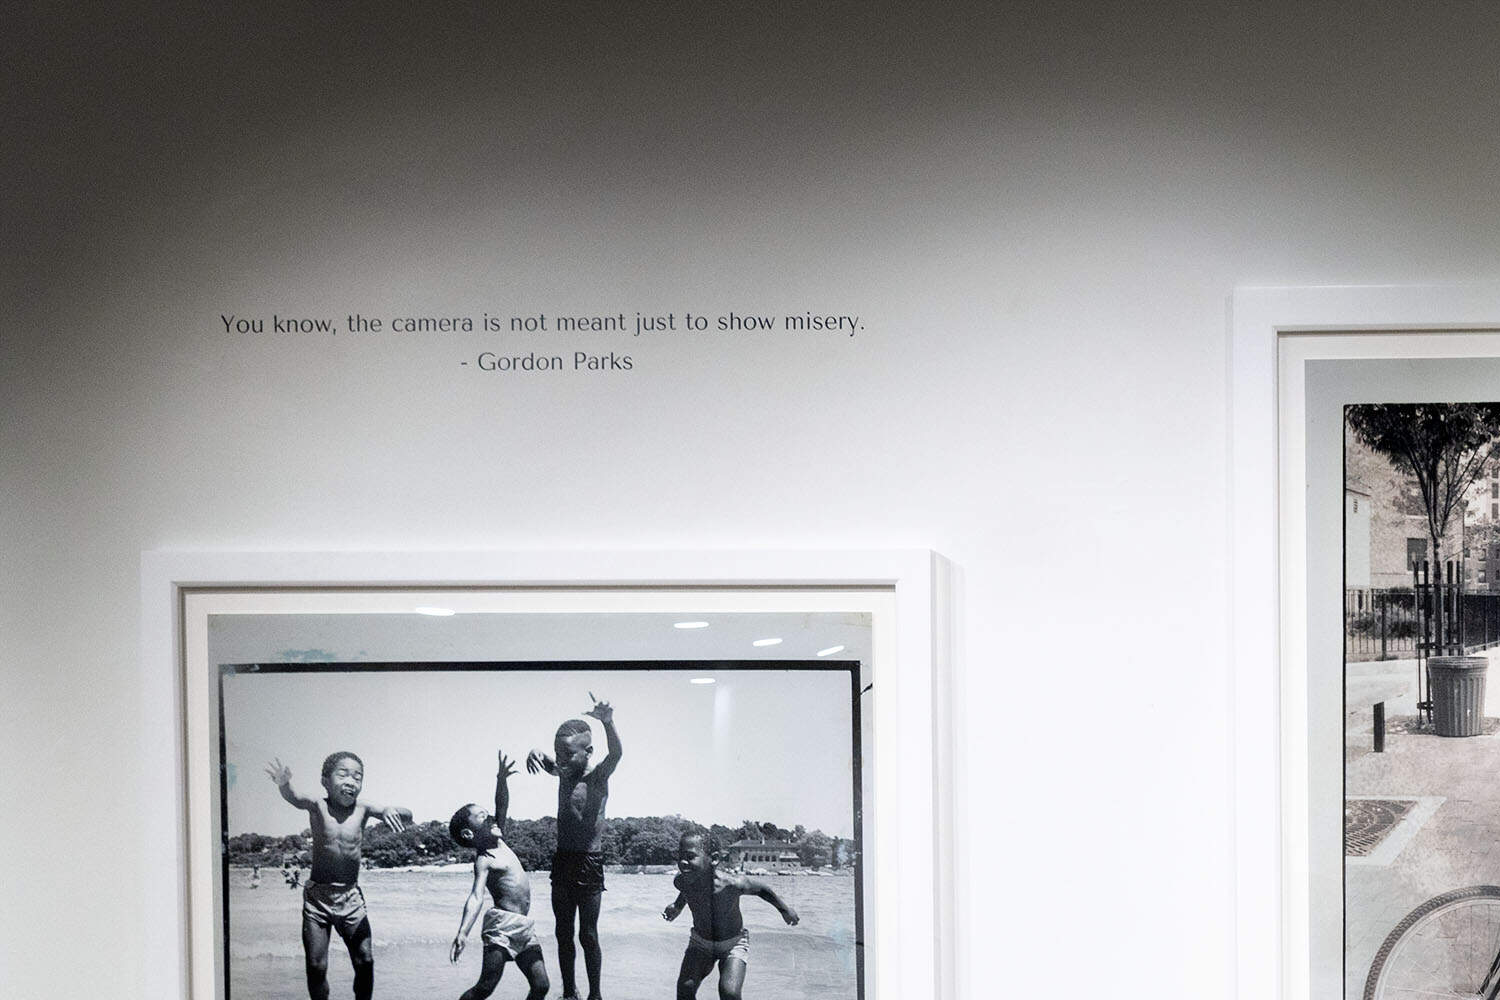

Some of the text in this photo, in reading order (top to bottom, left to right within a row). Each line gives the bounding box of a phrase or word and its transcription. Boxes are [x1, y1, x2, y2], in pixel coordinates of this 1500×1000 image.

[220, 311, 865, 337] You know, the camera is not meant just to show misery.
[477, 351, 563, 371] Gordon
[574, 352, 634, 371] Parks
